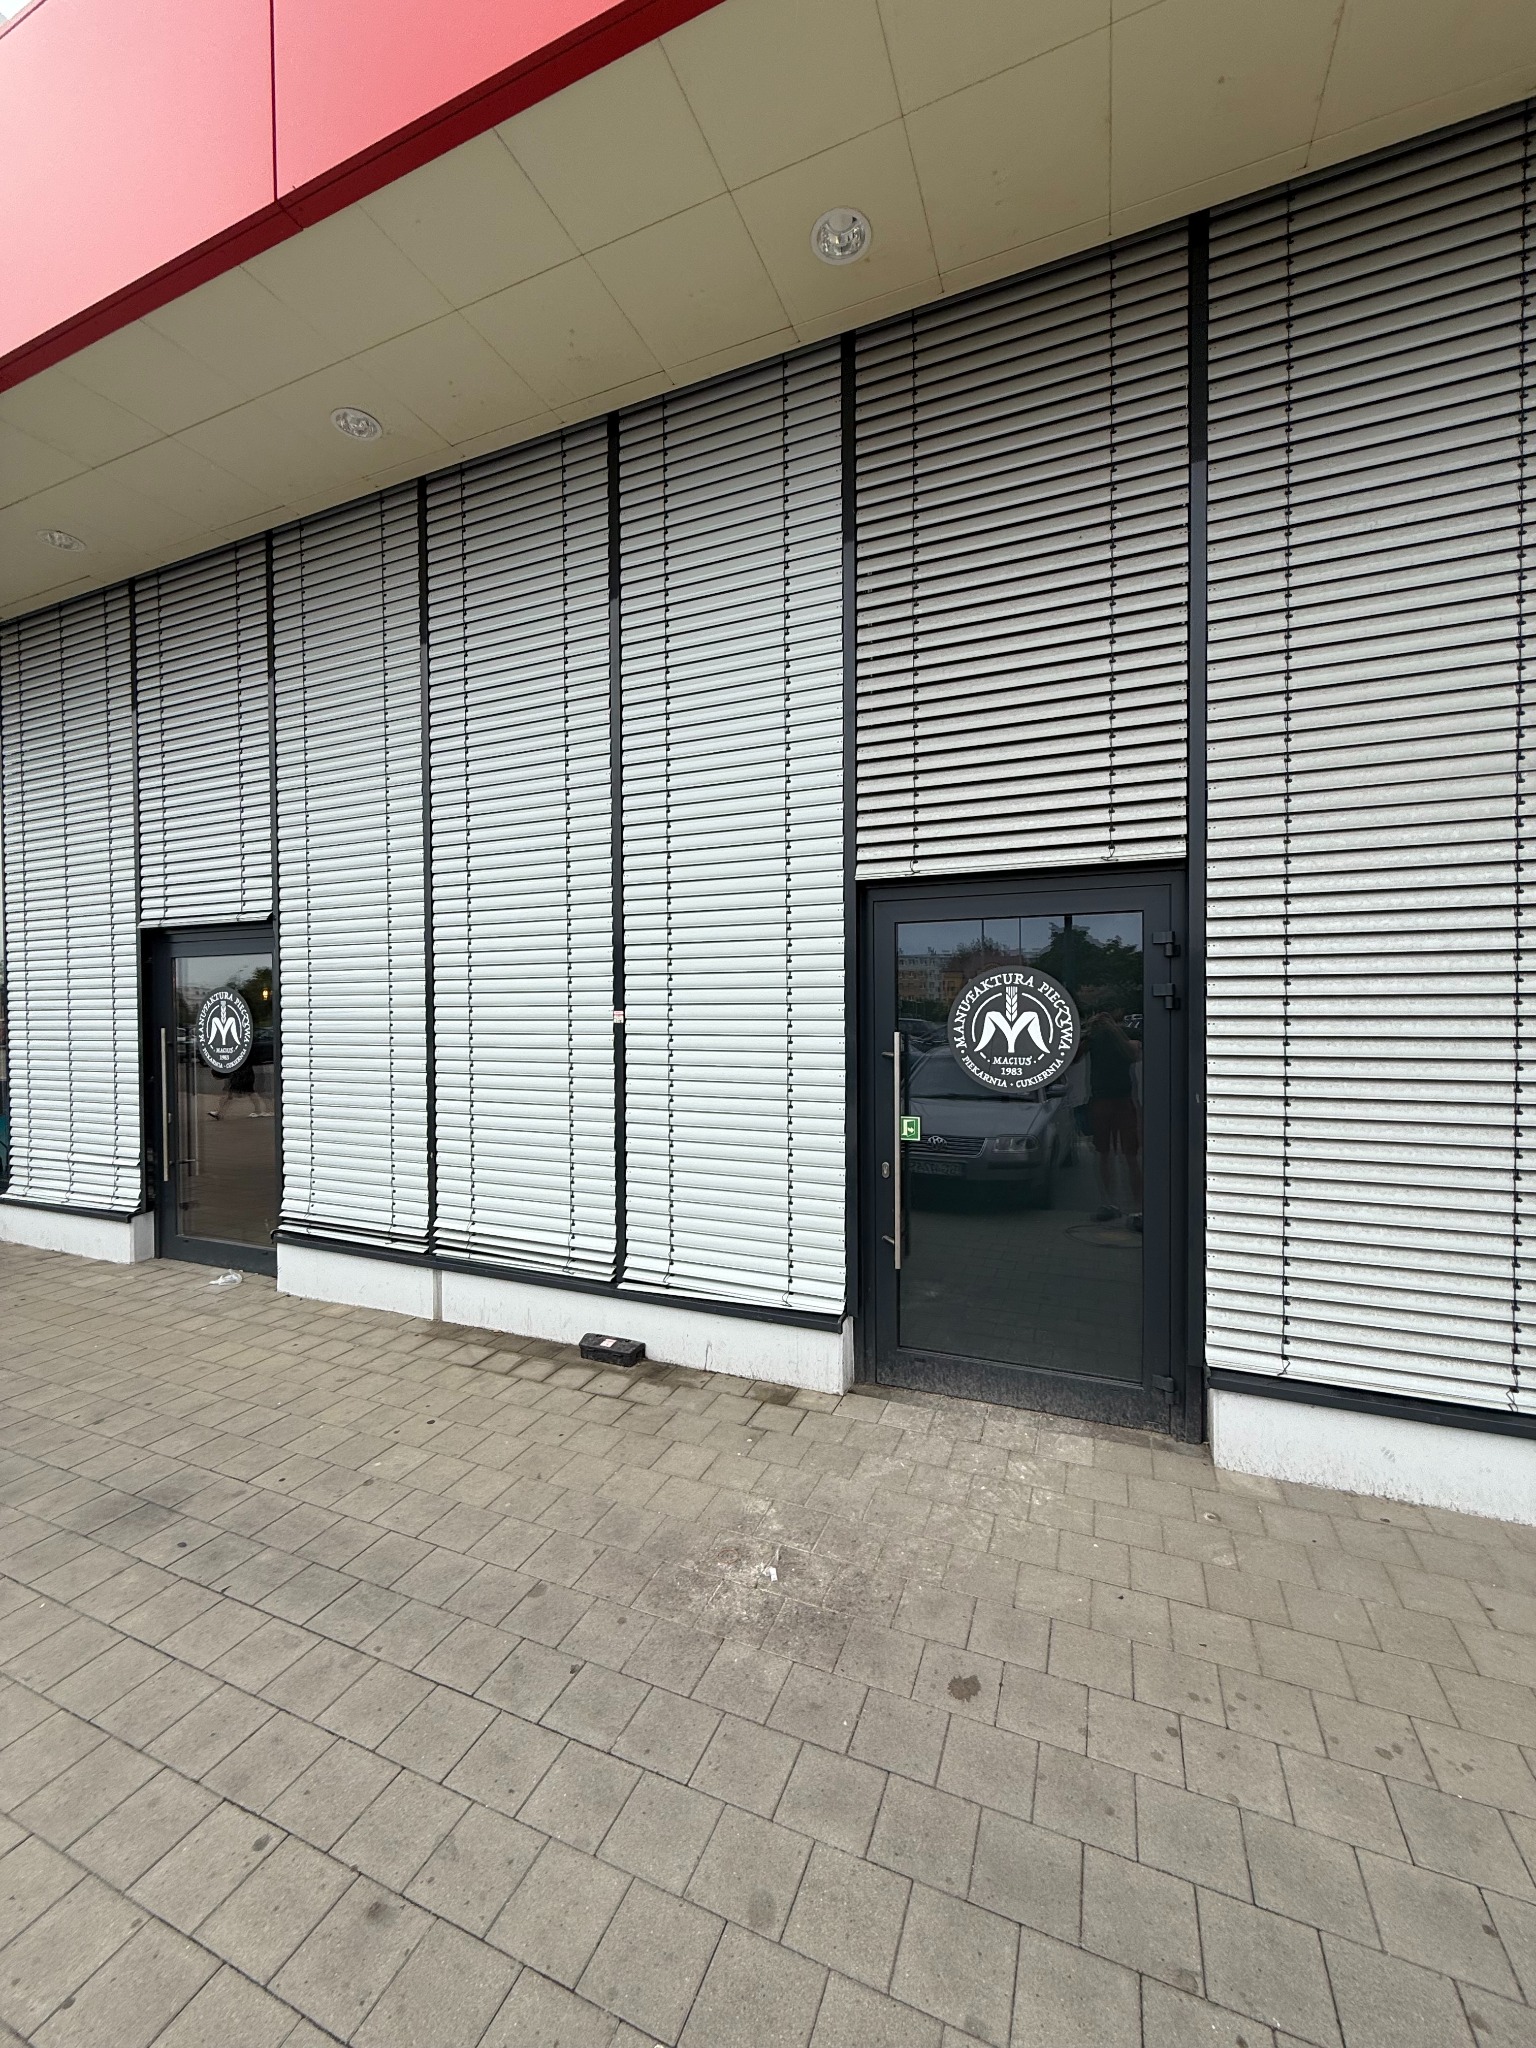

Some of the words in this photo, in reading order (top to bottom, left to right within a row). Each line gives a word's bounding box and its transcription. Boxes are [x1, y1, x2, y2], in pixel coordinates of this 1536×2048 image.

[199, 991, 233, 1043] MANUFAKTURA
[234, 997, 250, 1043] PIECZYWA
[953, 973, 1034, 1049] MANUFAKTURA
[1037, 981, 1073, 1050] PIECZYWA
[961, 1055, 1008, 1088] PIEKARNIA
[1015, 1058, 1064, 1088] CUKIERNIA
[1001, 1067, 1022, 1076] 1983
